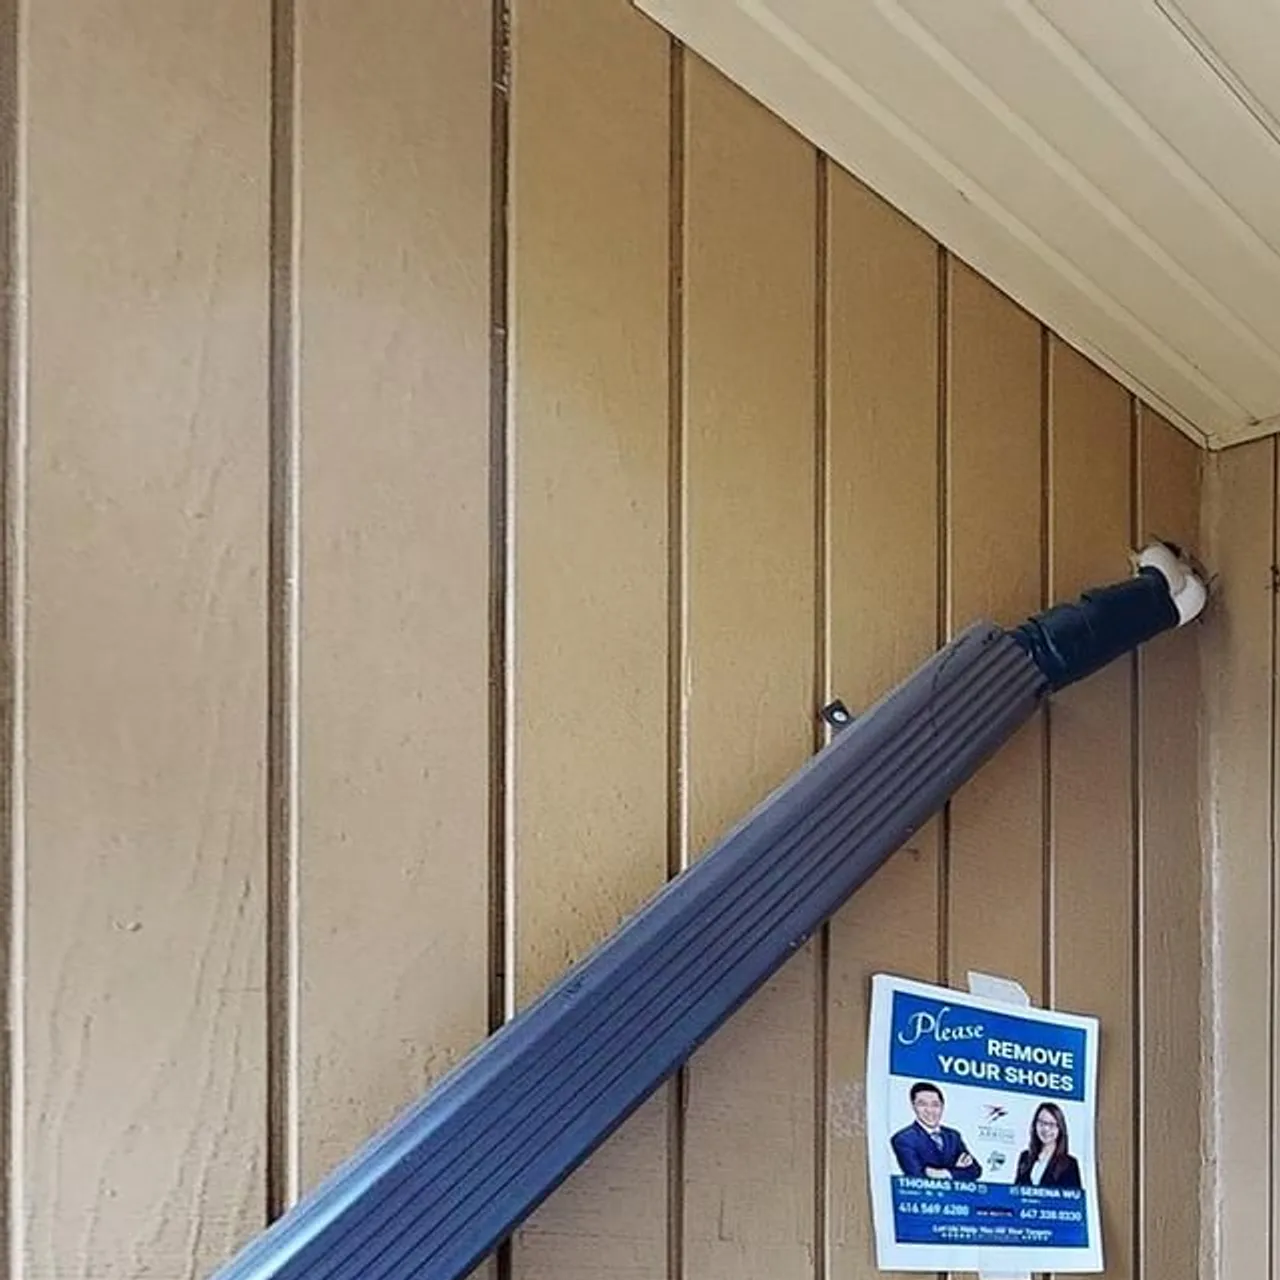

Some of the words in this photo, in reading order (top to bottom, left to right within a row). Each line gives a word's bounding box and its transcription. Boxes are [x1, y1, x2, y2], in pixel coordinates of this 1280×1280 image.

[898, 1007, 985, 1045] Please
[987, 1039, 1074, 1069] REMOVE
[938, 1055, 1001, 1081] YOUR
[1004, 1066, 1074, 1092] SHOES
[899, 1178, 951, 1191] THOMAS
[953, 1181, 977, 1193] TAO
[1062, 1190, 1081, 1200] WU
